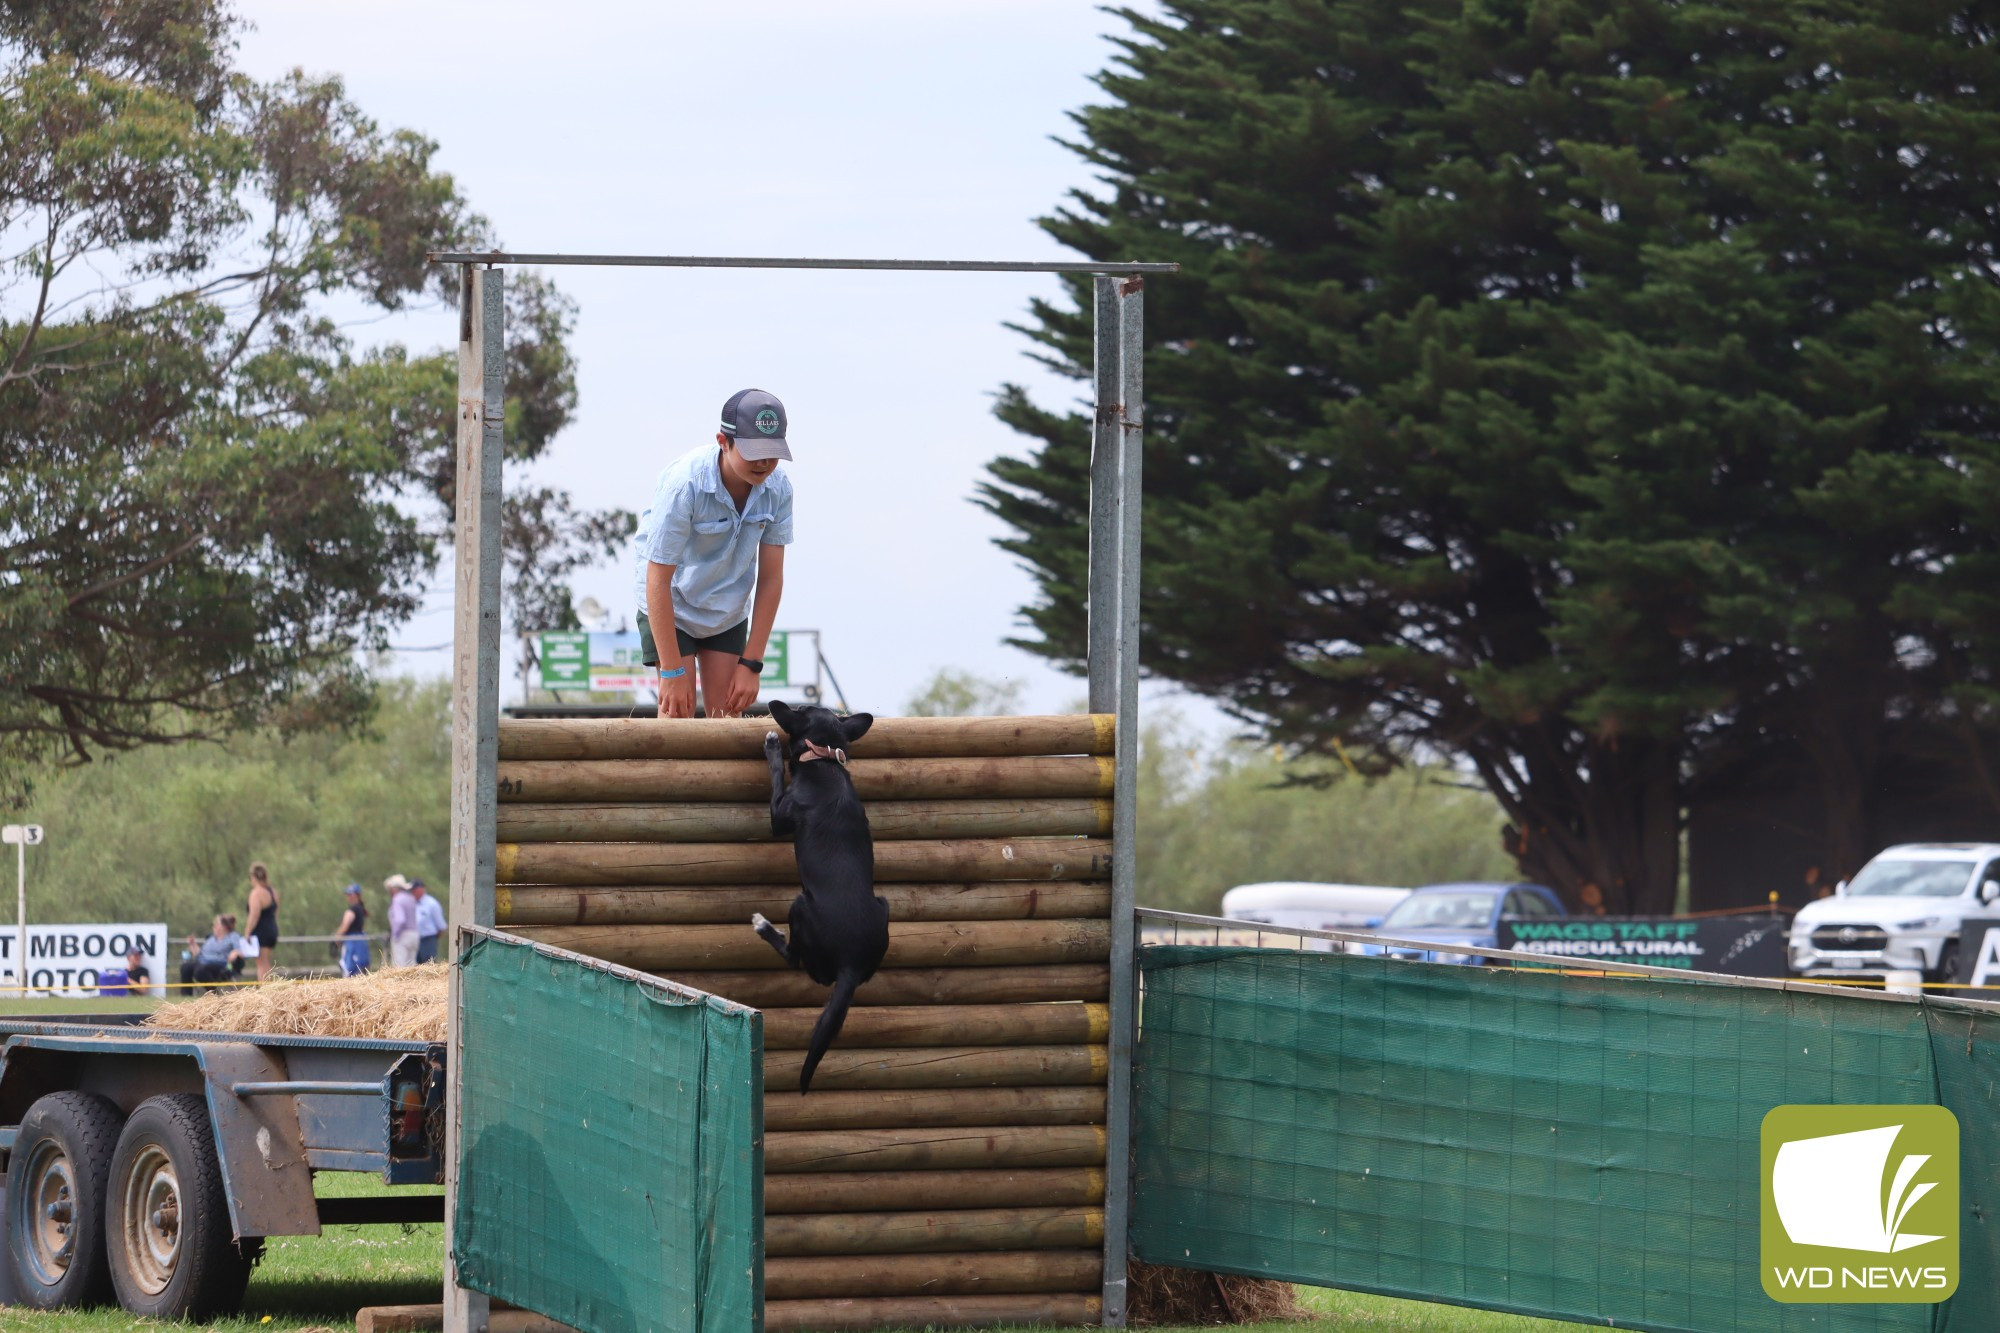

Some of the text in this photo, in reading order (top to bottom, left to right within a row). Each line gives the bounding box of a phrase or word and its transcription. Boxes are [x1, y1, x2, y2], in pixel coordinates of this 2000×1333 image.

[28, 828, 38, 841] 3
[1511, 923, 1699, 940] WAGSTAFF
[0, 934, 156, 959] TMBOON
[1511, 941, 1704, 956] AGRICULTURAL
